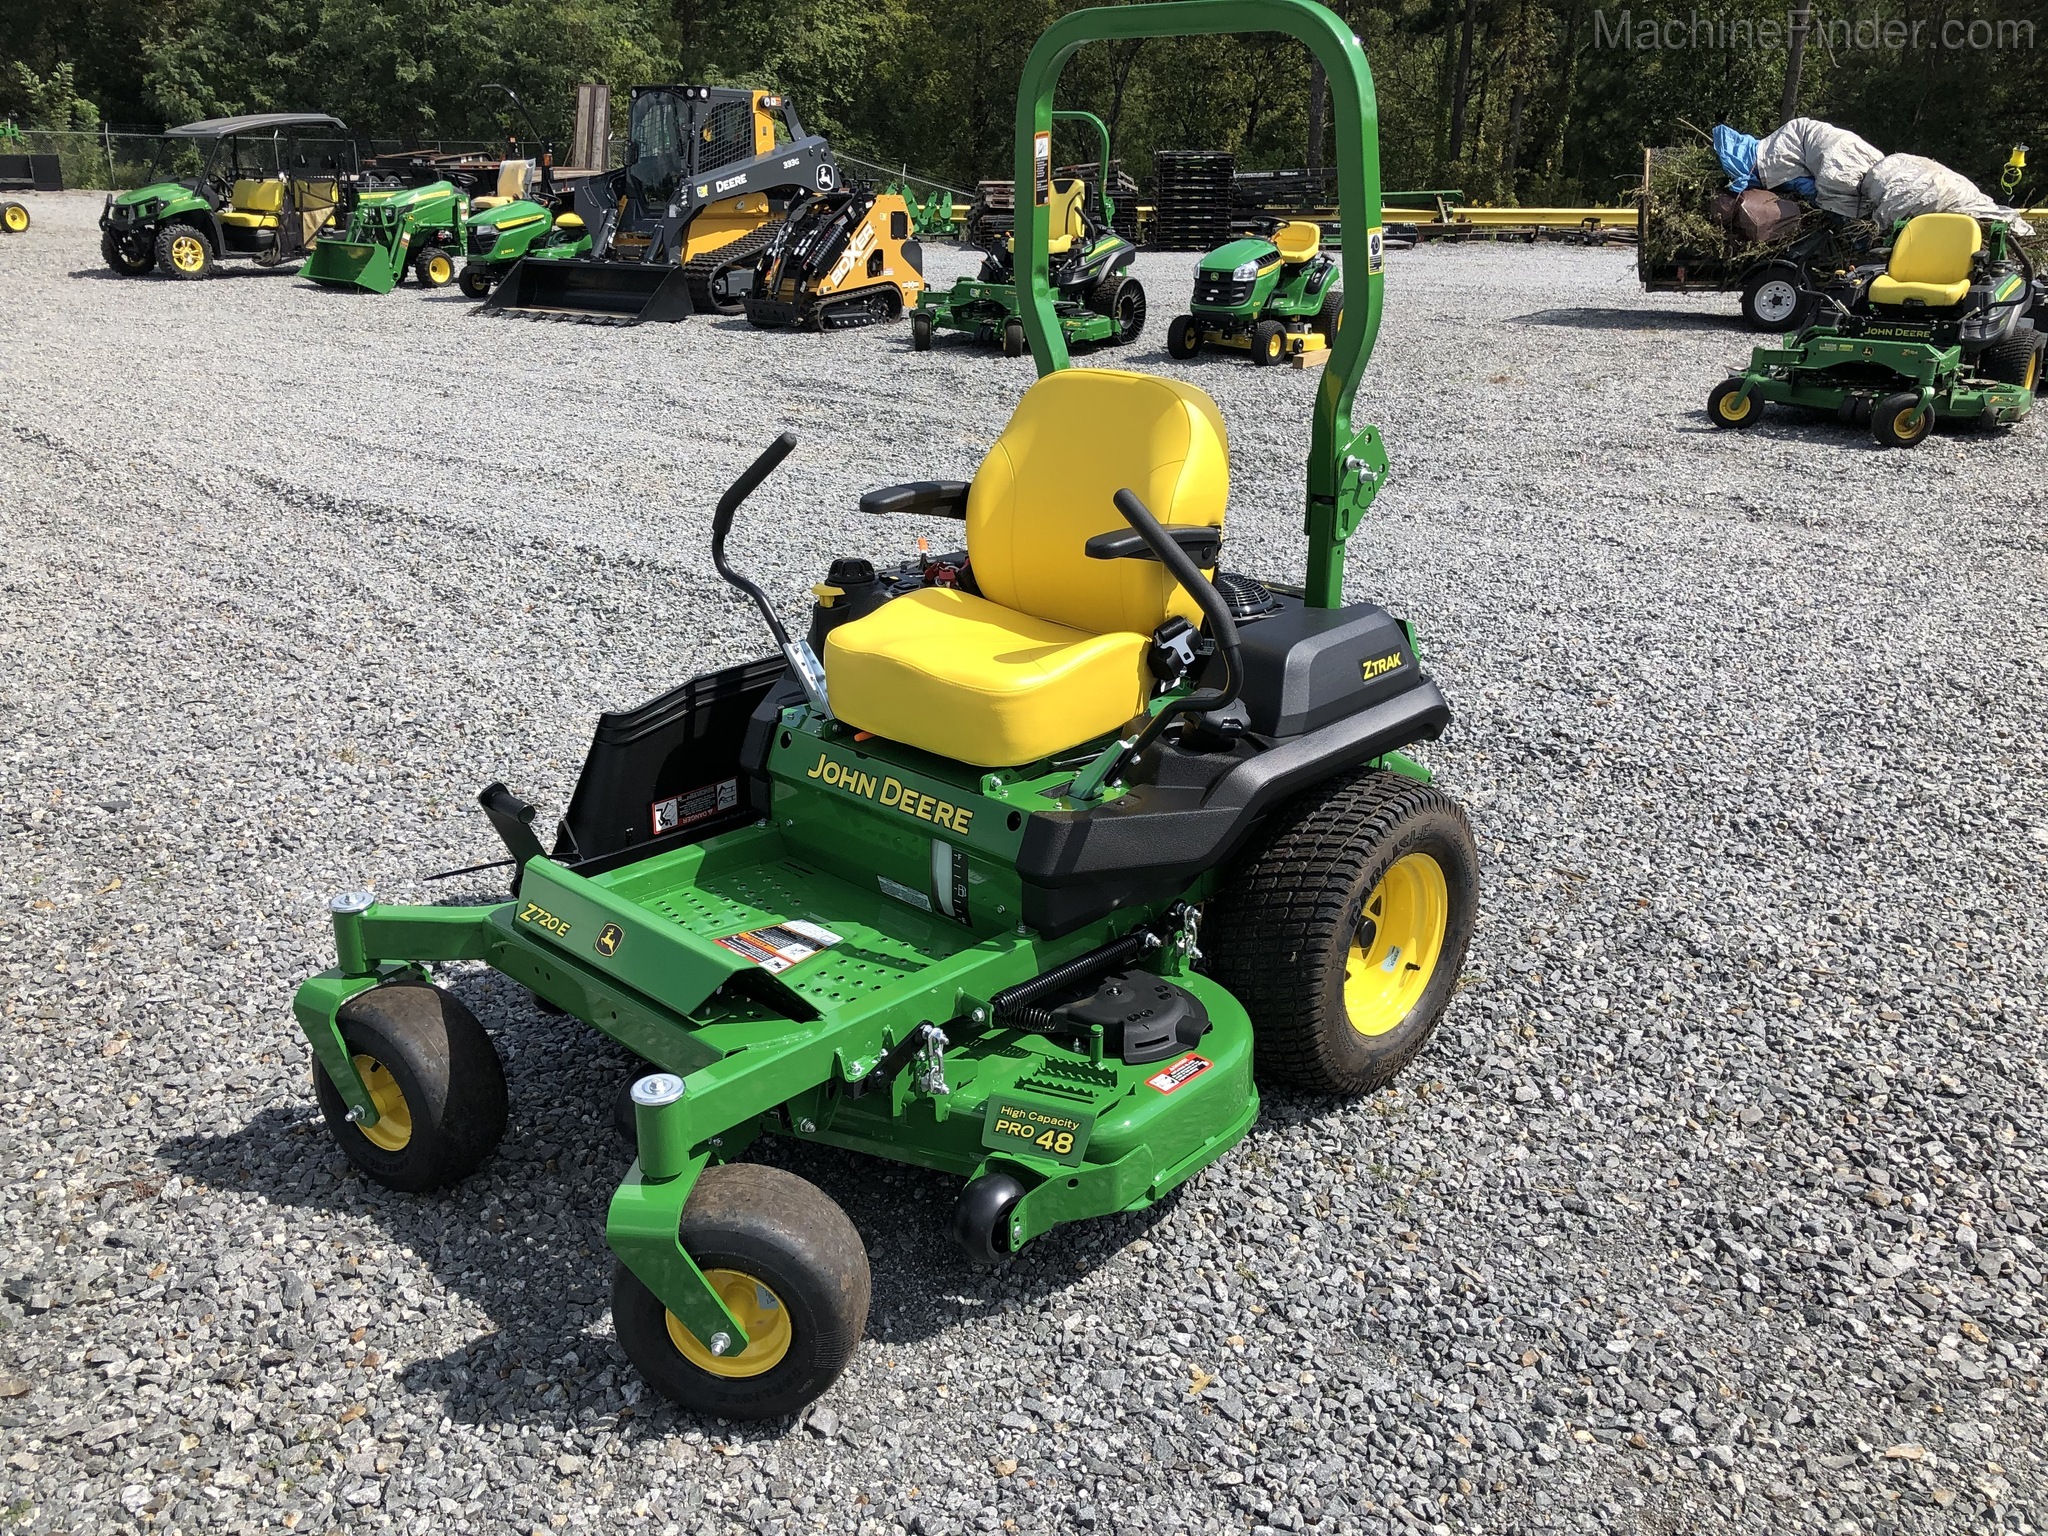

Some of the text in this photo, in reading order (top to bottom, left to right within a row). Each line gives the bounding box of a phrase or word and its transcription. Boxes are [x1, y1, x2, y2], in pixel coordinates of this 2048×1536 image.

[715, 173, 748, 193] DEERE
[829, 221, 876, 288] BOXER
[1864, 326, 1931, 338] JOHN DEERE
[1362, 651, 1402, 680] ZTRAK
[807, 753, 974, 836] JOHN DEERE
[1000, 1105, 1080, 1131] High Capacity
[995, 1119, 1074, 1154] PRO 48
